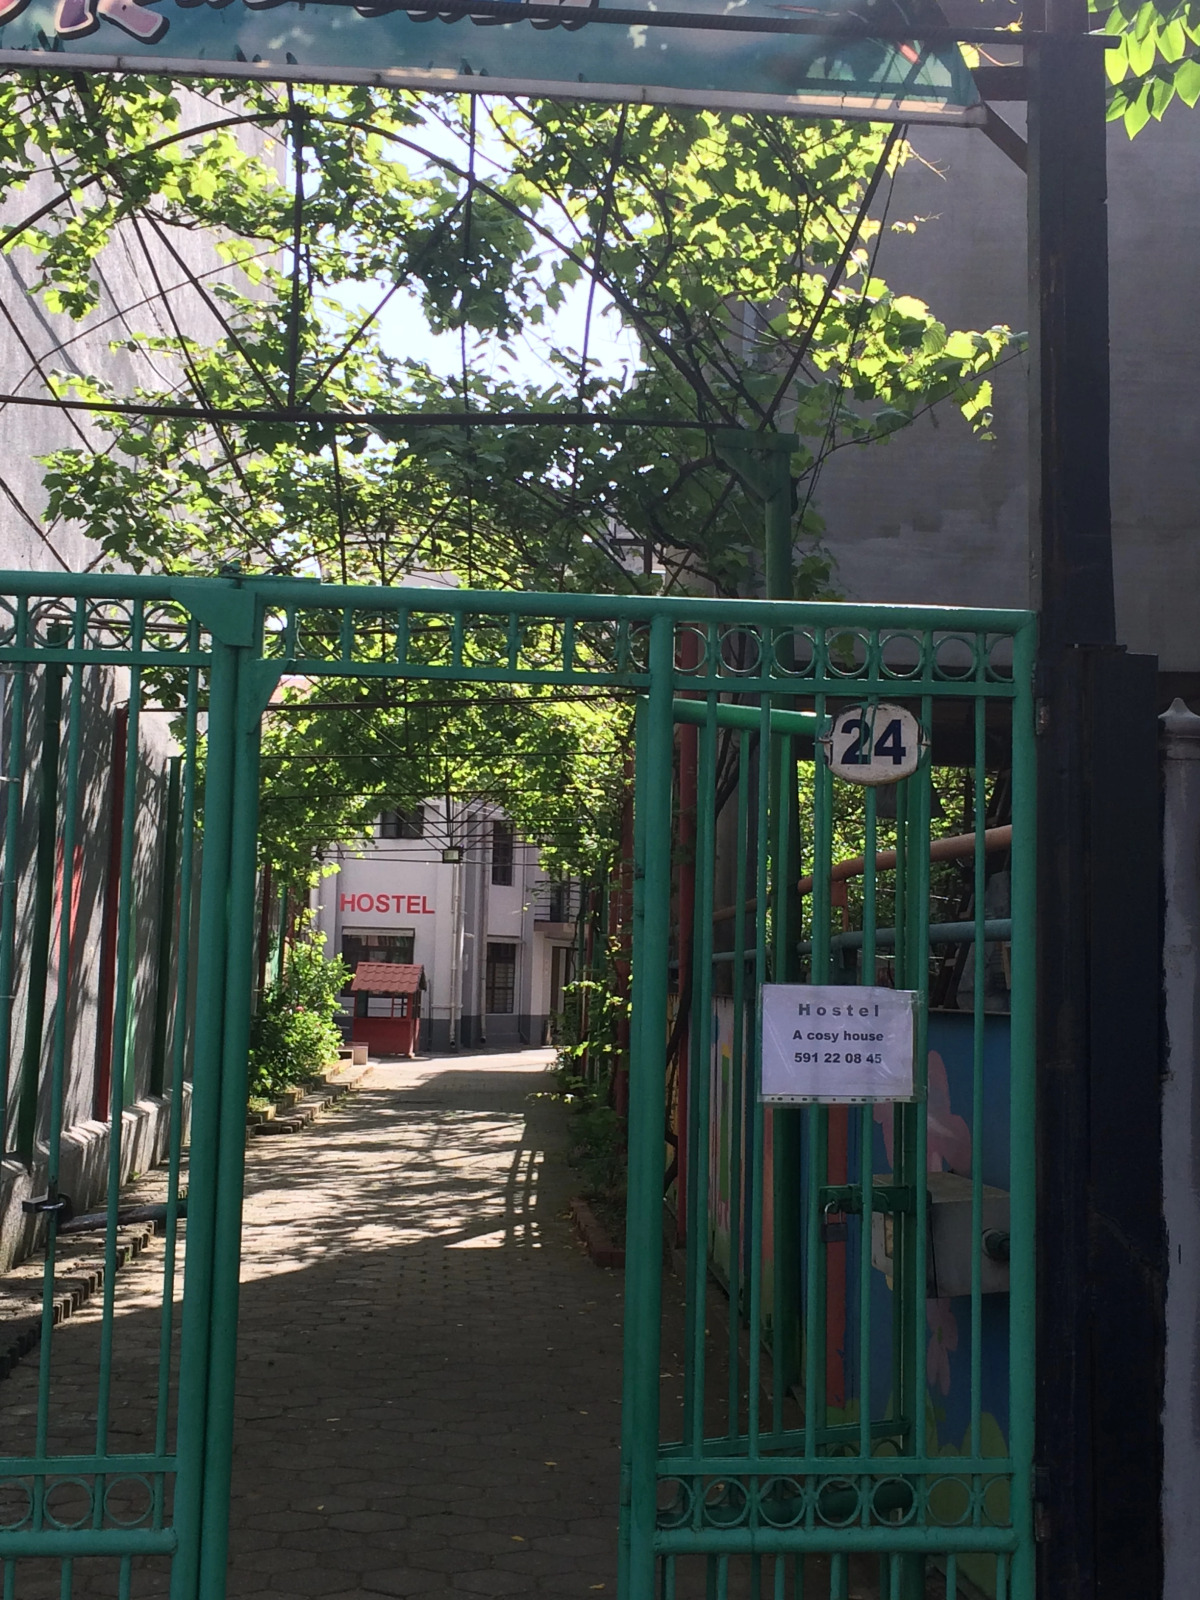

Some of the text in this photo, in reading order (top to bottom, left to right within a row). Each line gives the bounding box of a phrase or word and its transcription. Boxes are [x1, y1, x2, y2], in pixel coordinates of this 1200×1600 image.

[841, 718, 907, 765] 24
[340, 893, 435, 914] HOSTEL
[798, 1004, 879, 1017] Hostel
[792, 1030, 884, 1043] A cosy house
[794, 1052, 882, 1064] 591 22 08 45
